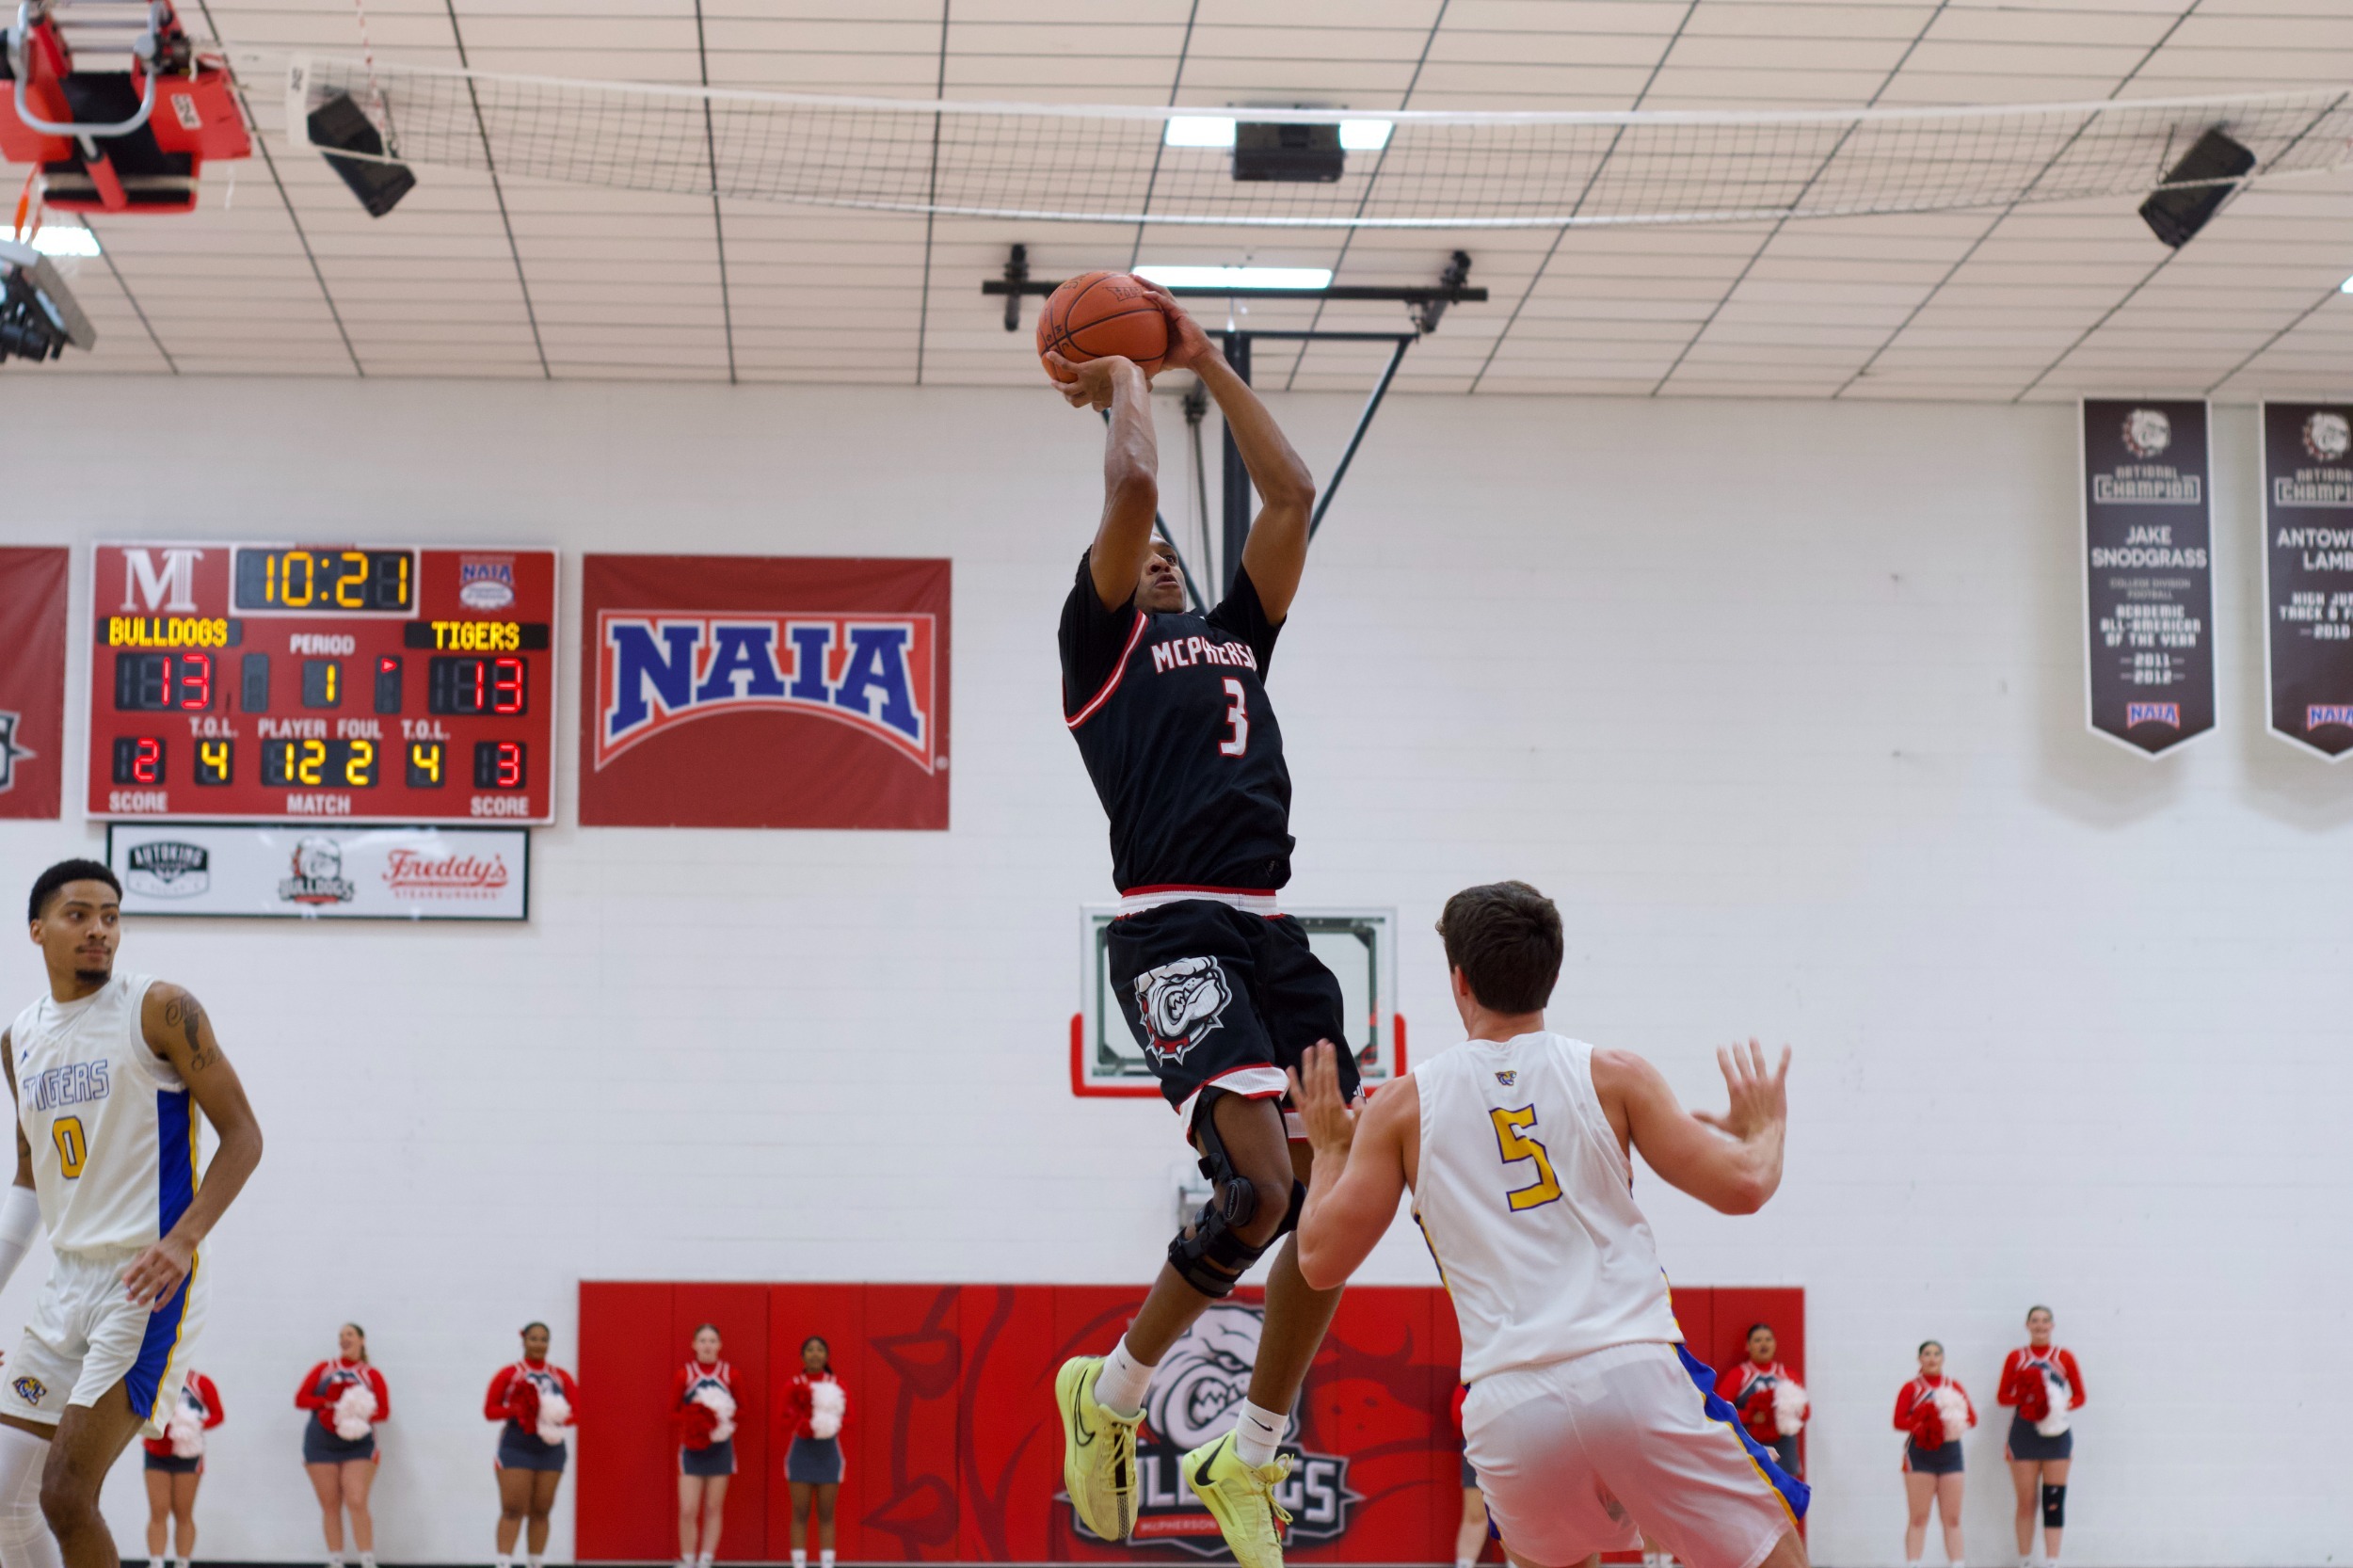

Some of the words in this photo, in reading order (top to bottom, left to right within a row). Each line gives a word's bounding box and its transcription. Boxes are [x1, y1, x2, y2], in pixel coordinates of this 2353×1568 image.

[2102, 479, 2195, 499] CHAMPION
[2125, 524, 2173, 546] JAKE
[2276, 527, 2353, 548] ANTOW
[2090, 547, 2208, 568] SNODGRASS
[120, 549, 205, 613] M
[264, 551, 408, 609] 10:21
[462, 565, 512, 584] NAIA
[2100, 617, 2201, 633] ALL-AMERICAN
[2115, 604, 2185, 618] ACADEMIC
[109, 617, 228, 648] BULLDOGS
[290, 633, 356, 656] PERIOD
[431, 621, 520, 651] TIGERS
[2105, 632, 2123, 647] OF
[2129, 632, 2155, 648] THE
[2160, 632, 2196, 648] YEAR
[1150, 635, 1257, 674] MCPHERS
[161, 653, 210, 709] 13
[326, 664, 337, 703] 1
[475, 658, 523, 713] 13
[603, 617, 925, 753] NAIA
[190, 717, 239, 739] T.O.L.
[257, 718, 328, 740] PLAYER
[337, 719, 383, 740] FOUL
[1218, 675, 1251, 760] 3
[2130, 704, 2178, 724] NAIA
[402, 719, 450, 741] T.O.L.
[133, 738, 160, 782] 2
[200, 741, 228, 781] 4
[285, 740, 327, 785] 12
[345, 740, 373, 785] 2
[412, 744, 440, 783] 4
[496, 743, 520, 787] 3
[109, 792, 168, 813] SCORE
[287, 794, 351, 816] MATCH
[471, 796, 529, 817] SCORE
[382, 849, 510, 889] Freddy's
[24, 1059, 110, 1112] TIGERS
[52, 1114, 88, 1180] 0
[1488, 1103, 1563, 1212] 5
